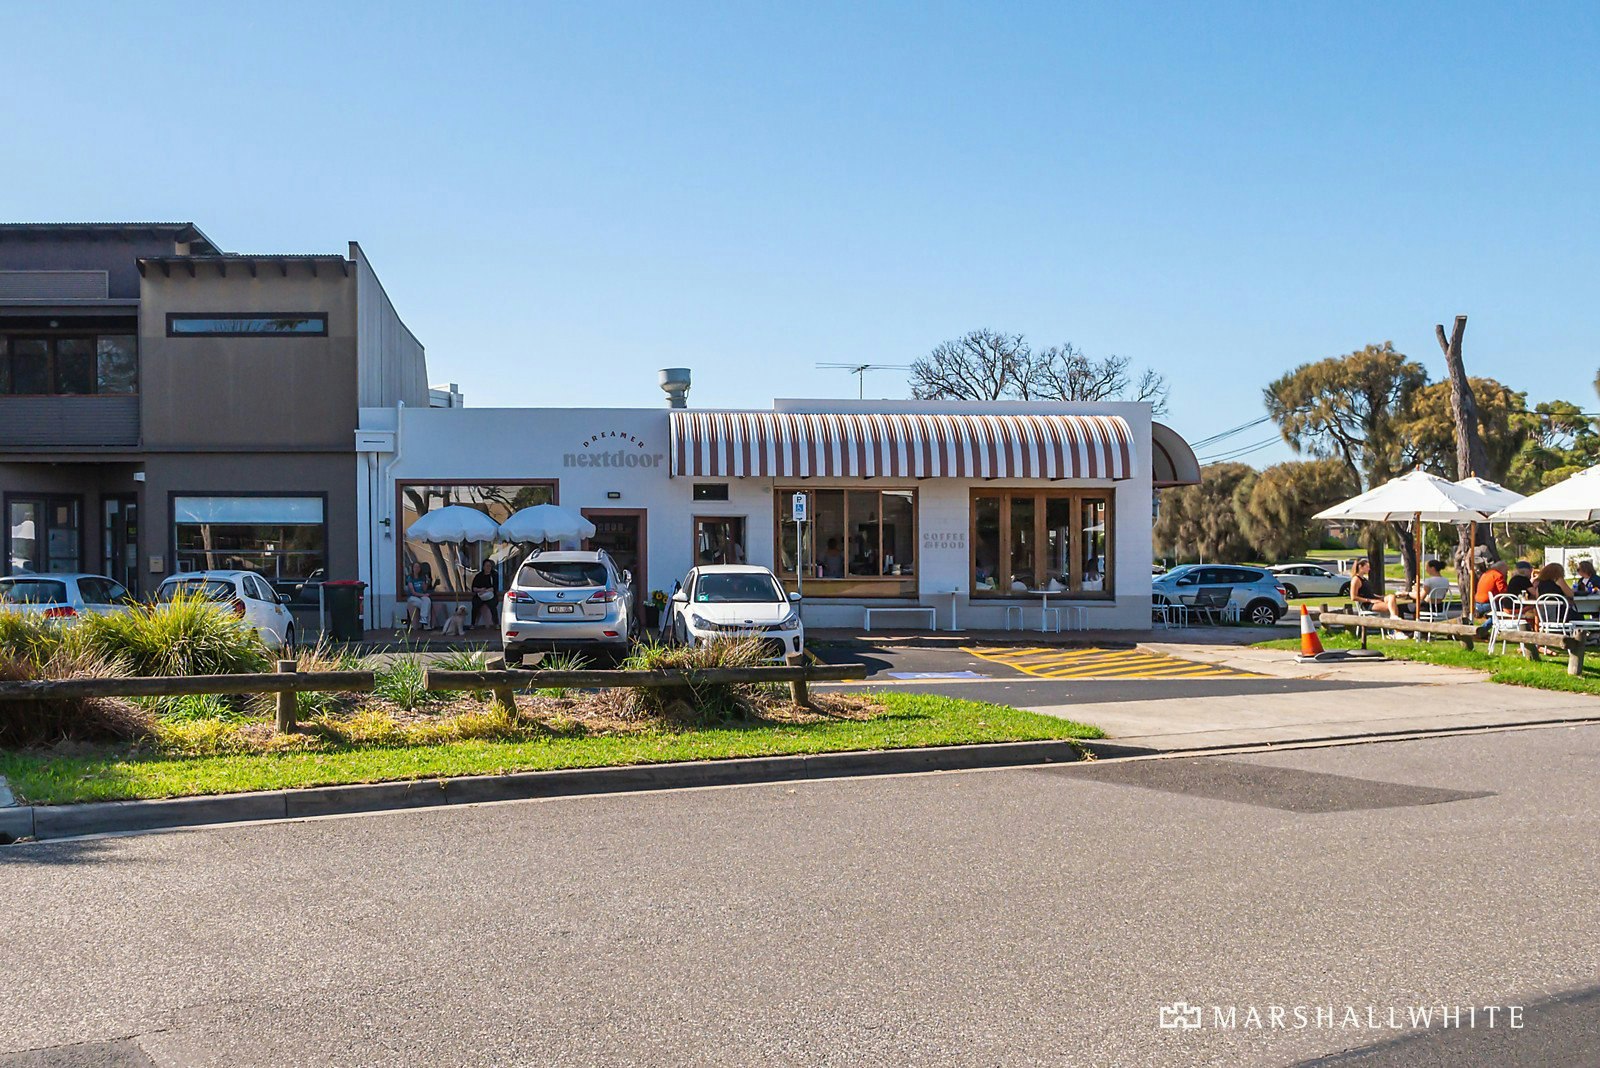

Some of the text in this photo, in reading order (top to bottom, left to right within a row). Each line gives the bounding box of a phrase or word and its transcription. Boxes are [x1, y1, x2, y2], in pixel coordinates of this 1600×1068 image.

[583, 430, 645, 449] DREAMER
[563, 450, 664, 468] nextdoor
[923, 533, 965, 541] COFFEE
